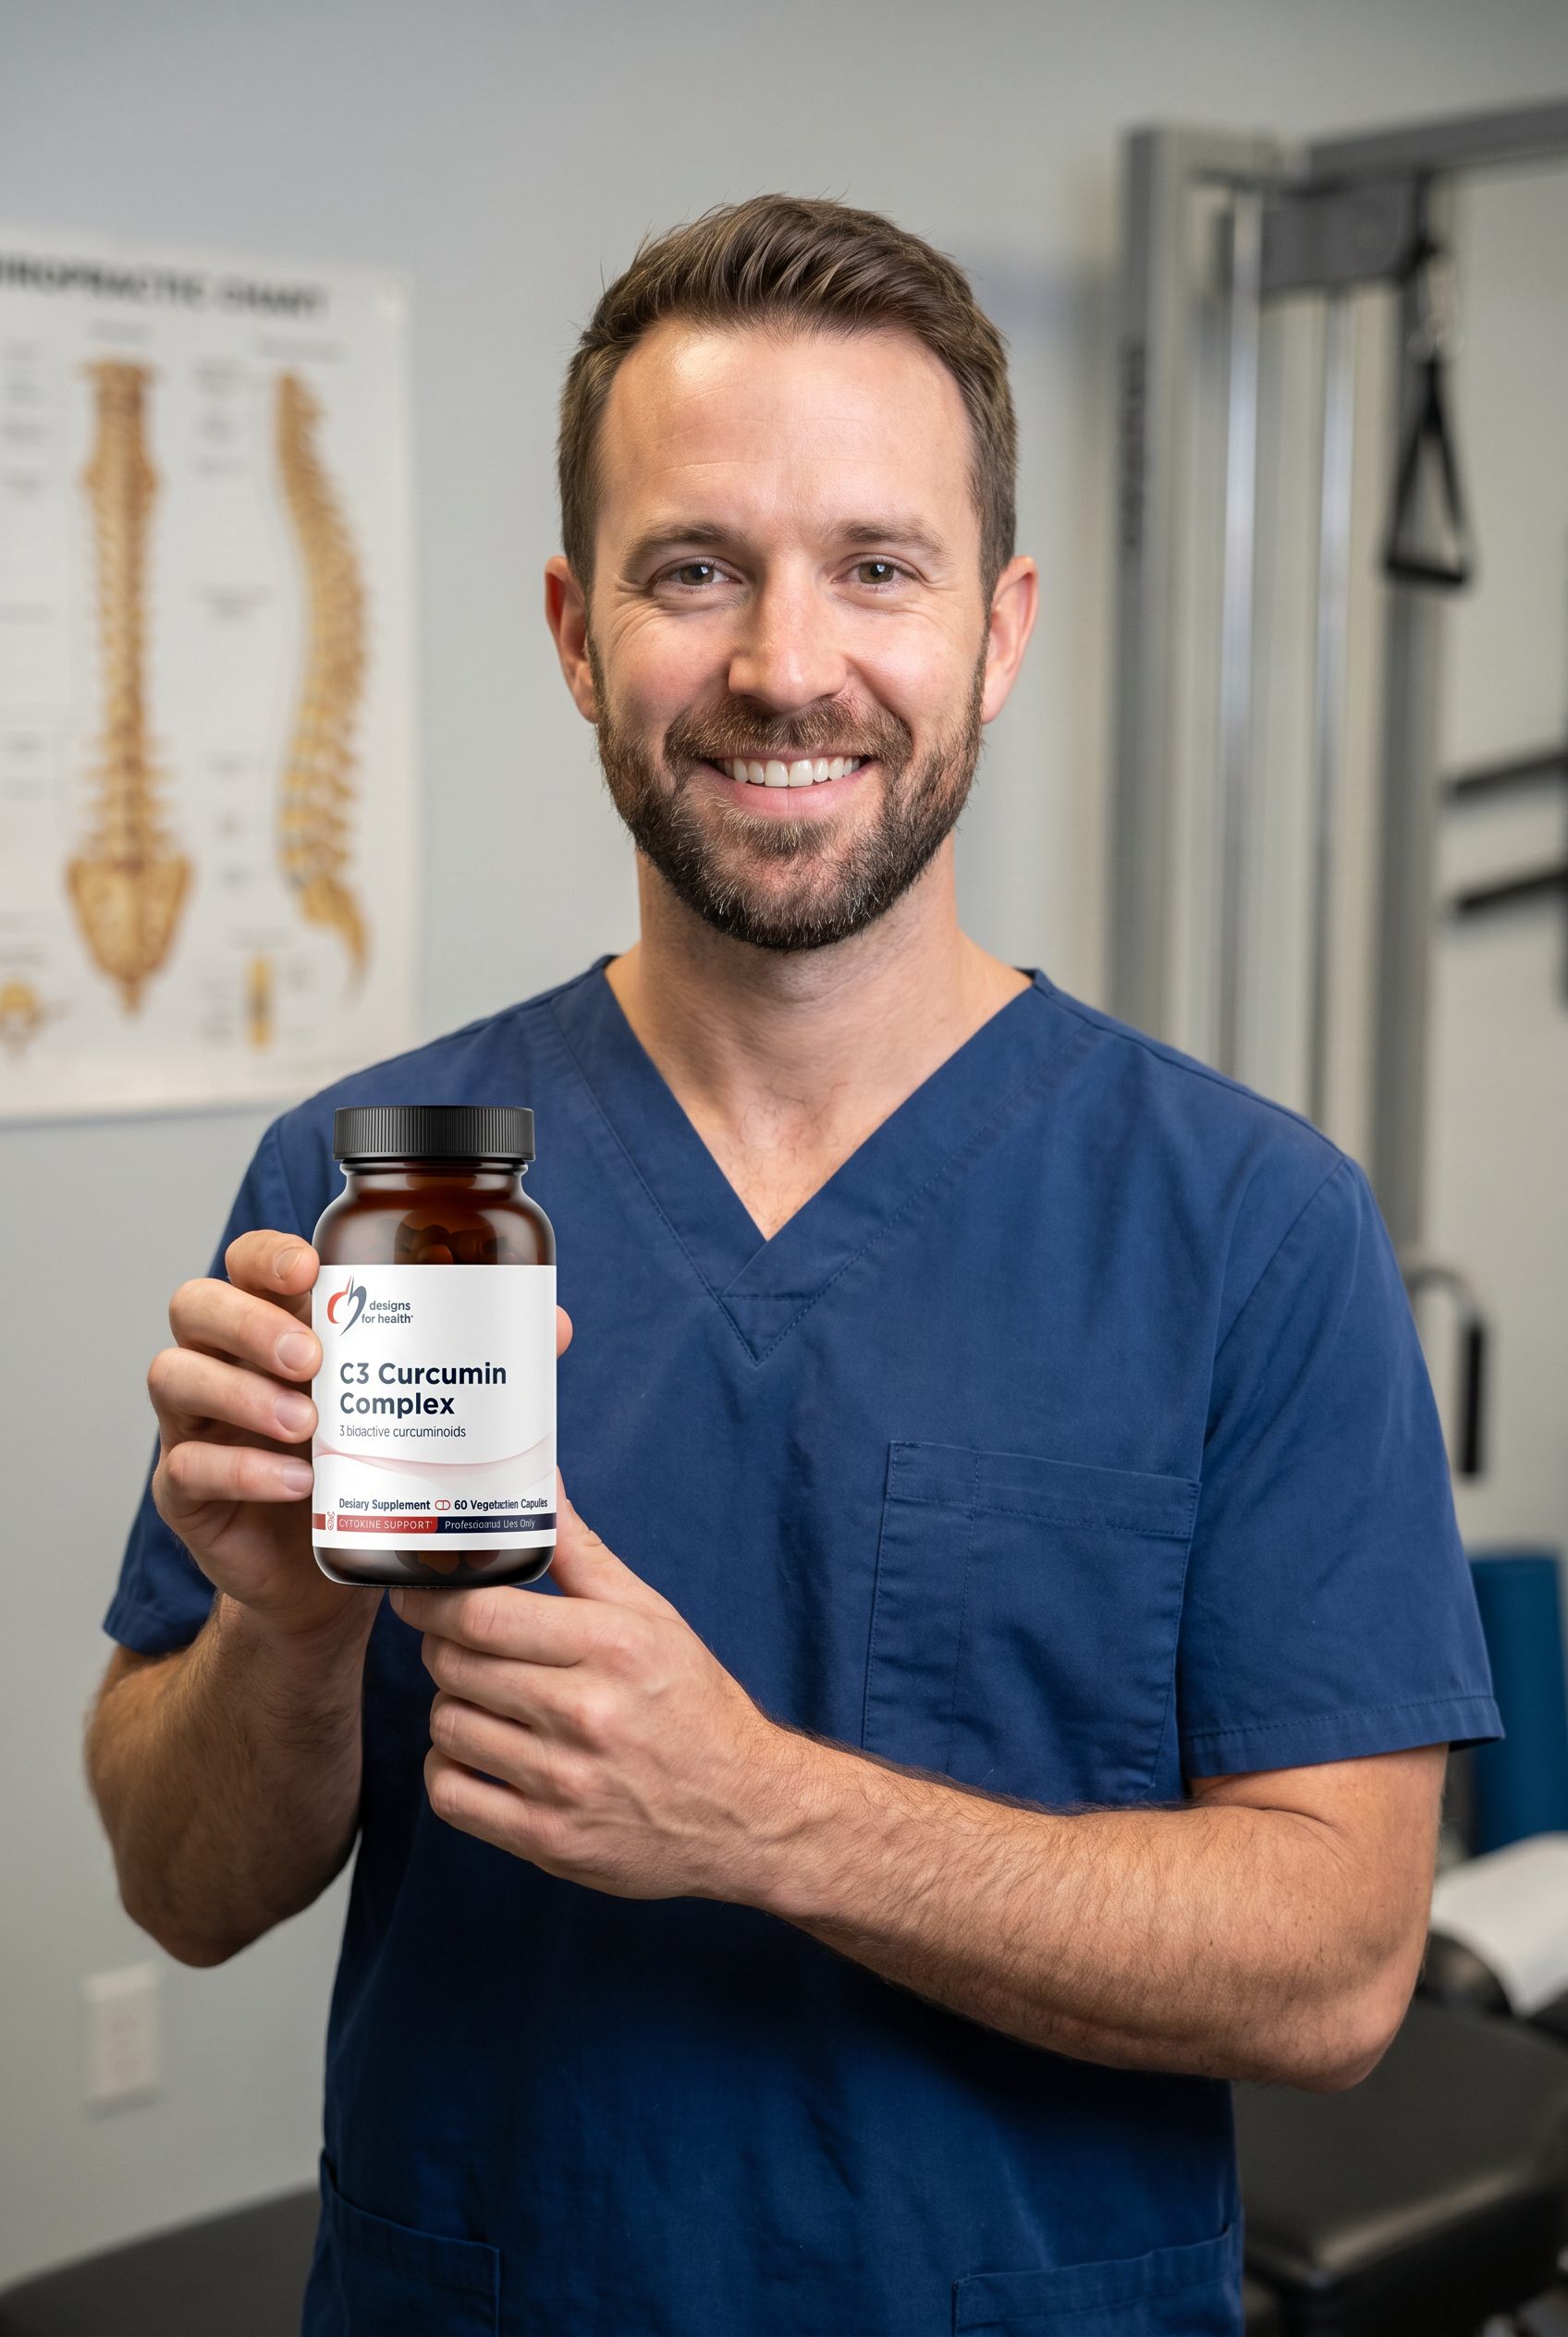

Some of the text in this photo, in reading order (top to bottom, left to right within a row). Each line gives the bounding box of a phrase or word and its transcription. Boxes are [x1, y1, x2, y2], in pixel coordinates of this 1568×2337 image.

[369, 1300, 410, 1313] designs
[361, 1314, 375, 1324] for
[339, 1362, 507, 1385] C3 Curcumin
[339, 1391, 455, 1419] Complex
[339, 1425, 345, 1437] 3
[393, 1425, 466, 1438] curcuminoids
[372, 1499, 431, 1511] Supplement
[454, 1499, 468, 1510] 60
[338, 1519, 430, 1530] CYTOKINE SUPPORT
[520, 1518, 535, 1530] Only
